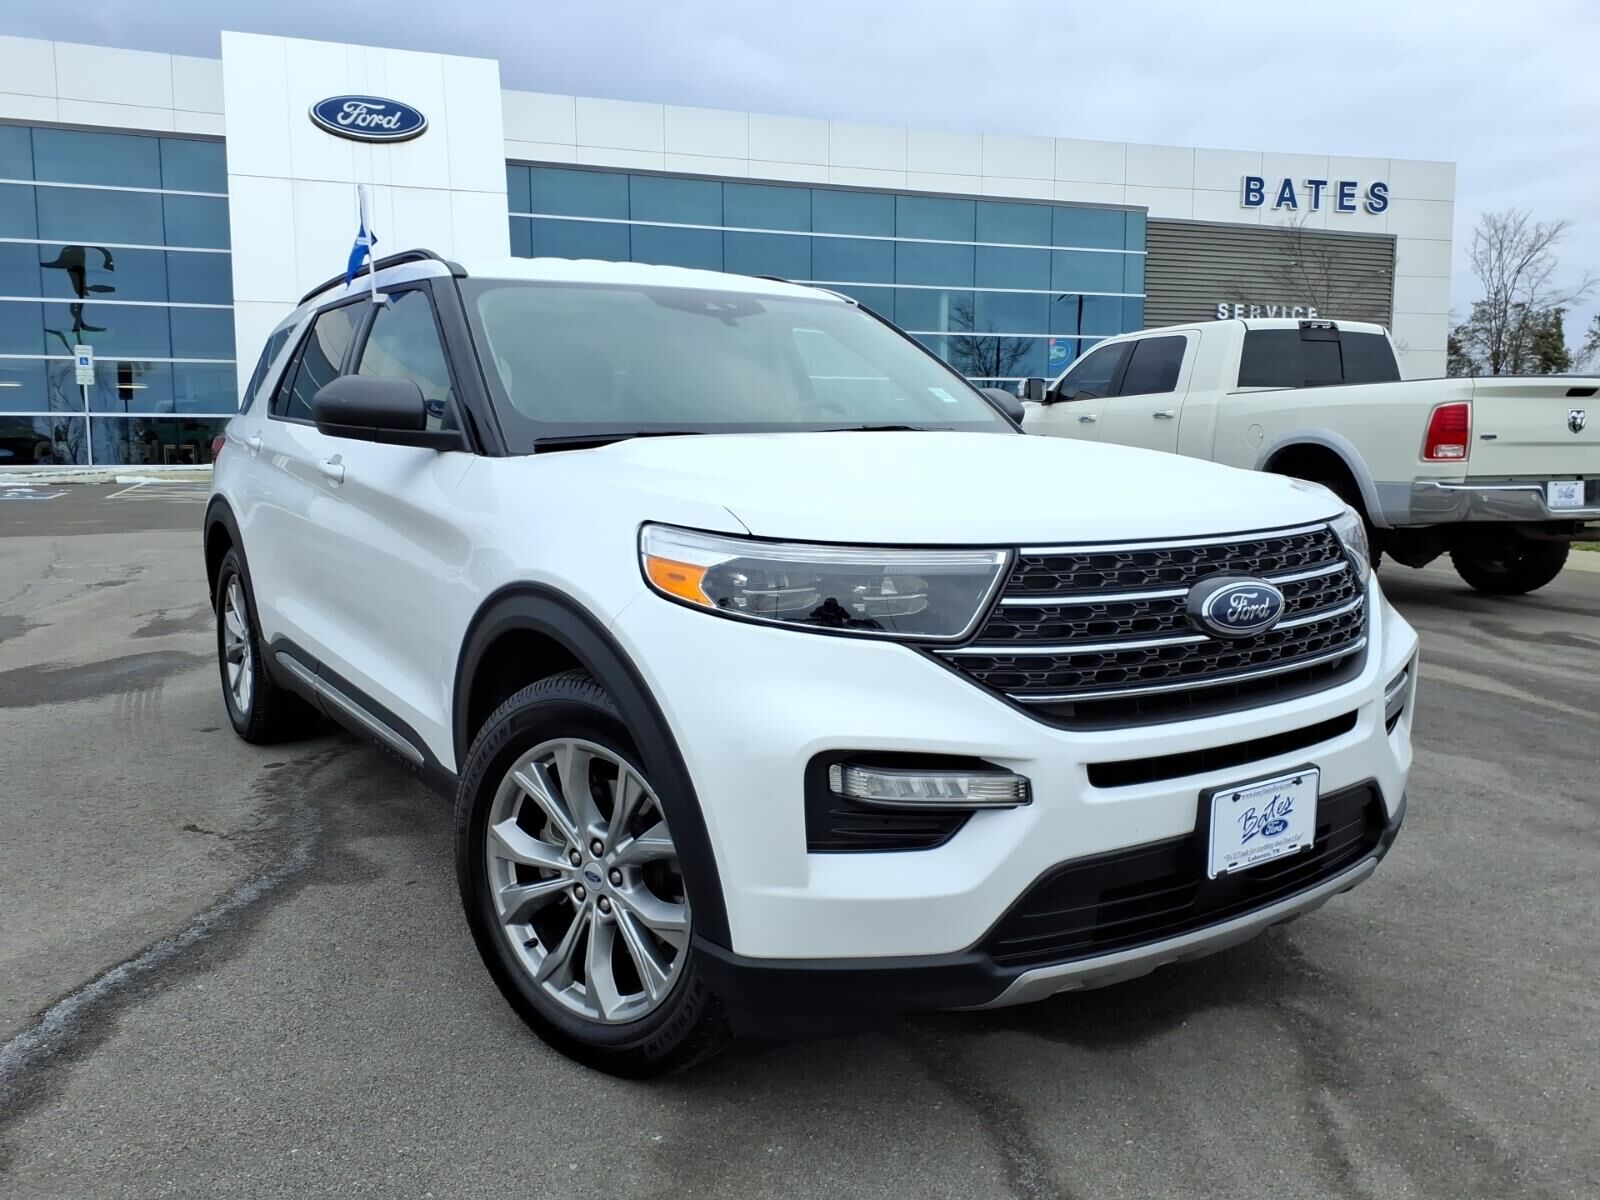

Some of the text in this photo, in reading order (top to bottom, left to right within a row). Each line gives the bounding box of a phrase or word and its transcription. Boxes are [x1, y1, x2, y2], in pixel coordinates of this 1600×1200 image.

[336, 101, 402, 129] Ford
[1242, 176, 1390, 214] BATES
[1216, 302, 1319, 320] SERVICE
[1227, 592, 1270, 623] Ford
[1238, 794, 1294, 842] Bates
